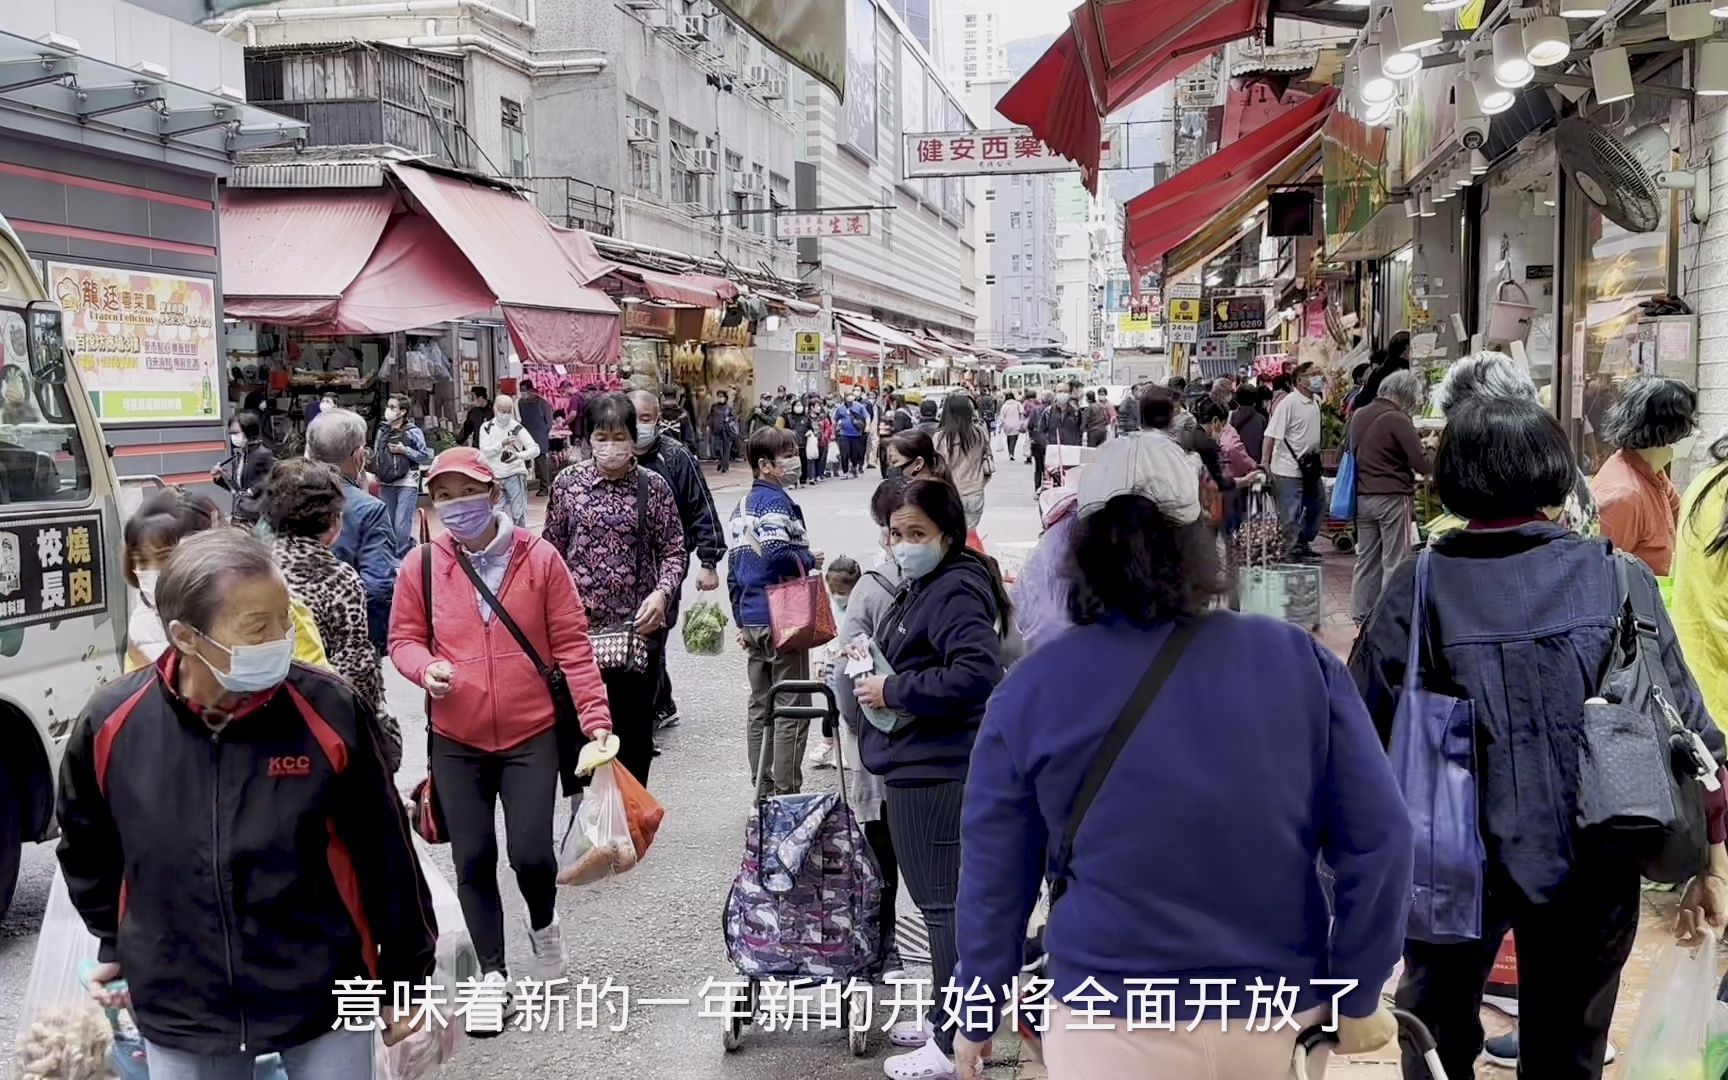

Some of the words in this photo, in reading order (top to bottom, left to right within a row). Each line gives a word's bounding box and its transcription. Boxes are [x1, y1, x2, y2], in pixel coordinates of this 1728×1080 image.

[37, 527, 66, 610] 校長
[66, 526, 92, 607] 燒肉
[269, 755, 310, 770] KCC
